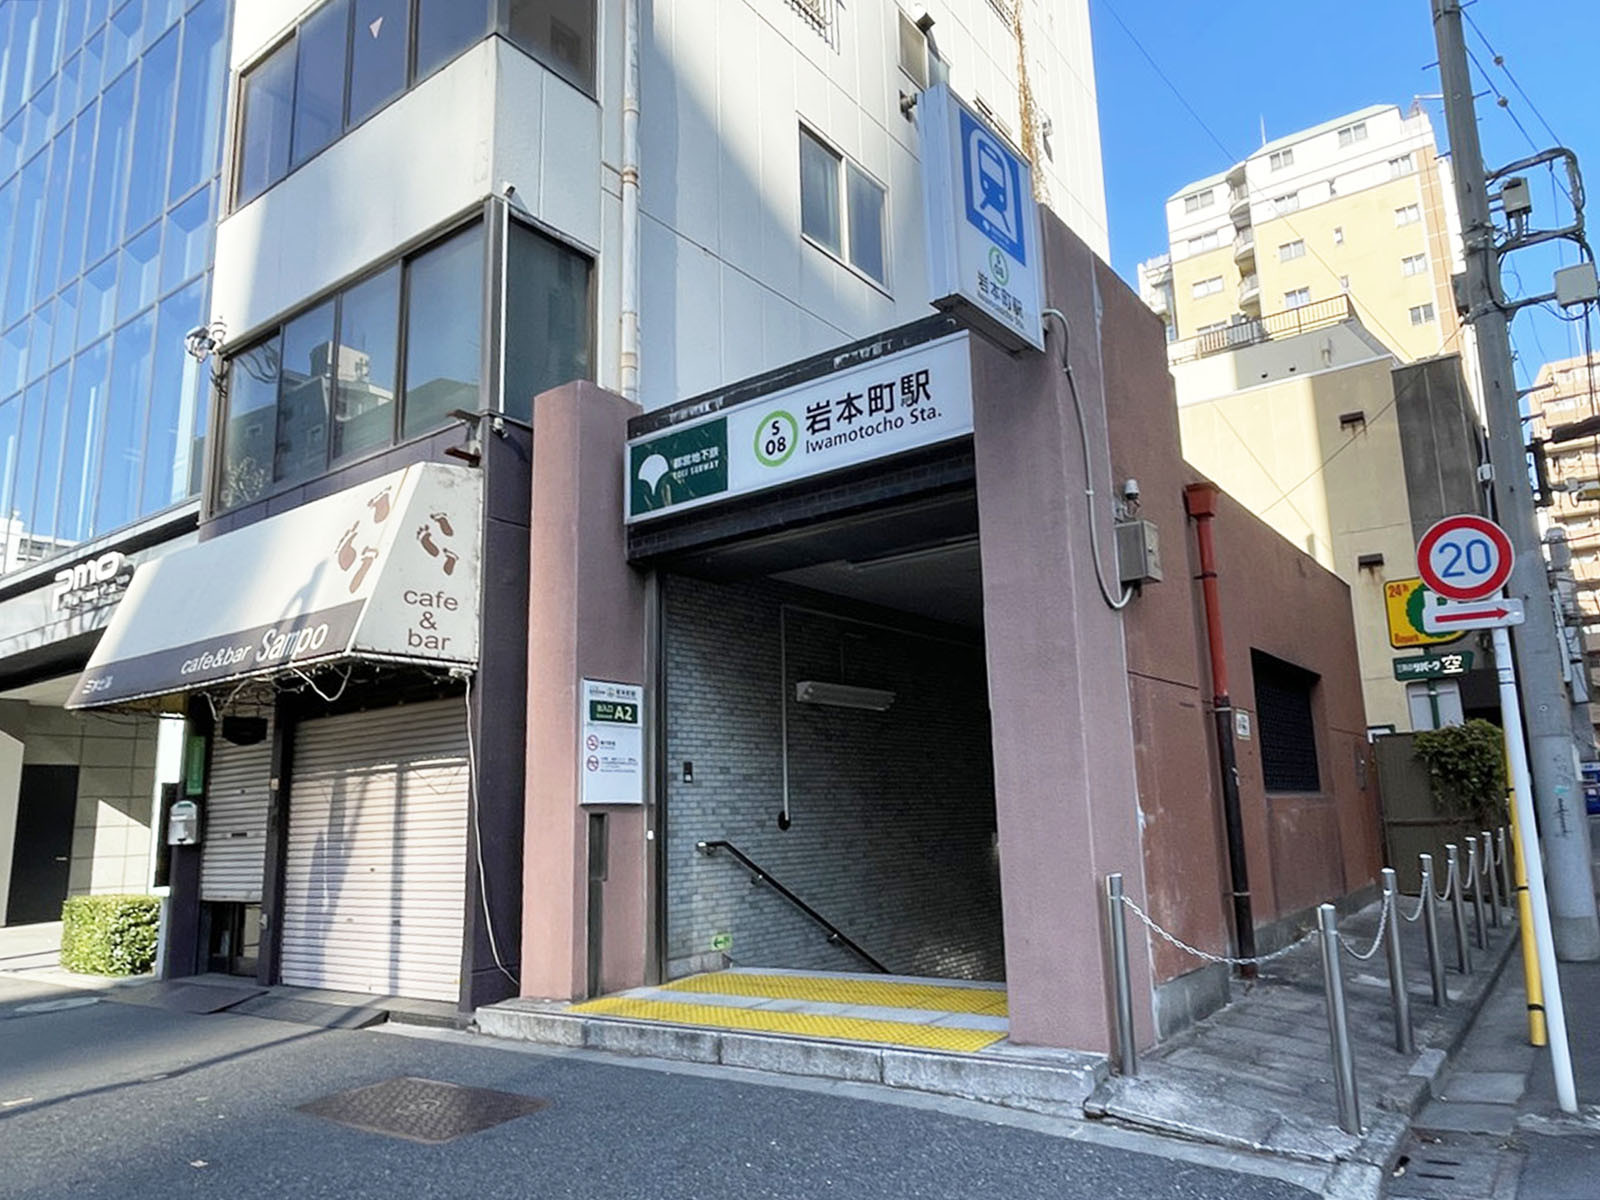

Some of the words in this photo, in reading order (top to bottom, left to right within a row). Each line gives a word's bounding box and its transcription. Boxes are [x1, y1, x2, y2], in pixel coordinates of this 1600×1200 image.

[805, 368, 931, 435] 岩本町駅
[771, 420, 780, 436] S
[805, 416, 904, 454] Iwamotocho
[910, 405, 942, 425] Sta.
[765, 436, 786, 456] 08
[1438, 538, 1492, 579] 20
[403, 590, 458, 611] cafe
[419, 610, 437, 630] &
[180, 644, 252, 674] cafe&bar
[256, 623, 329, 662] Sampo
[408, 628, 451, 650] bar
[1441, 654, 1464, 674] 空
[614, 705, 633, 721] A2
